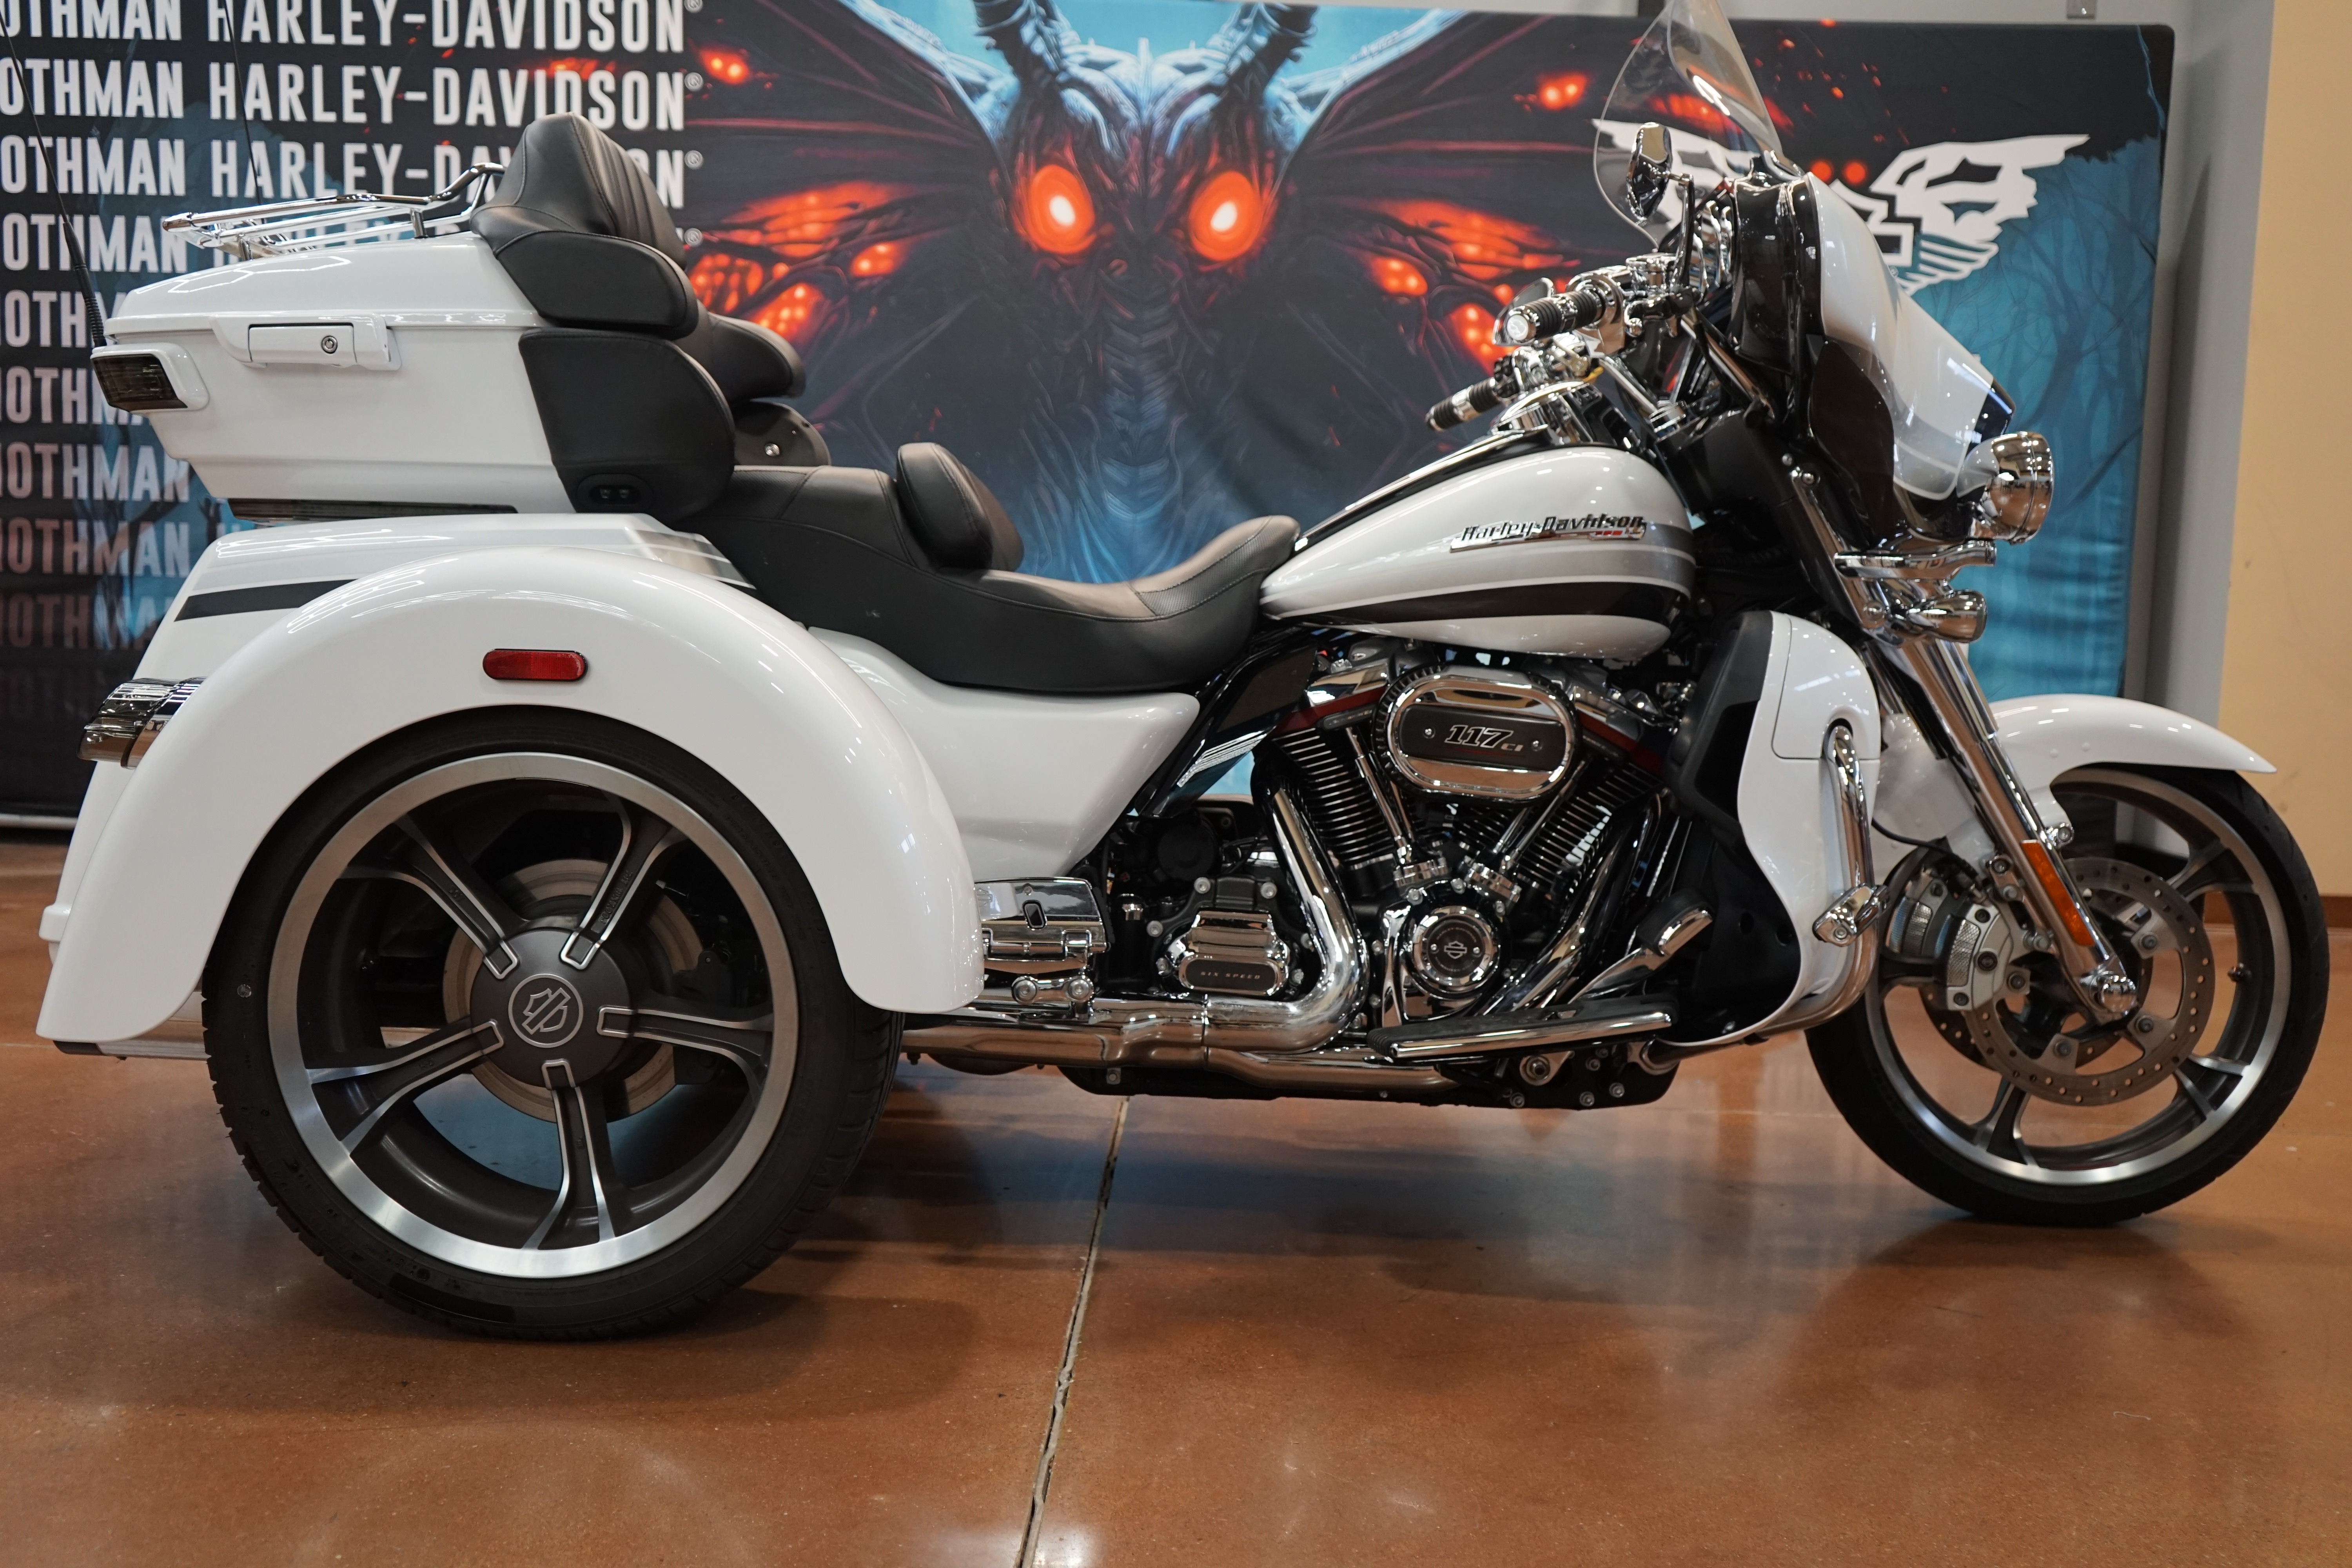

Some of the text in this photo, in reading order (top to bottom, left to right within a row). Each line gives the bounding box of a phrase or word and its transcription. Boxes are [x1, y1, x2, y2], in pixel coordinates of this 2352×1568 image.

[1, 134, 186, 197] OTHMAN
[0, 442, 190, 502] OTHMAN
[0, 517, 191, 578] OTHMAN
[1459, 513, 1646, 543] Harley-Davidson
[1444, 724, 1524, 752] 117 CI
